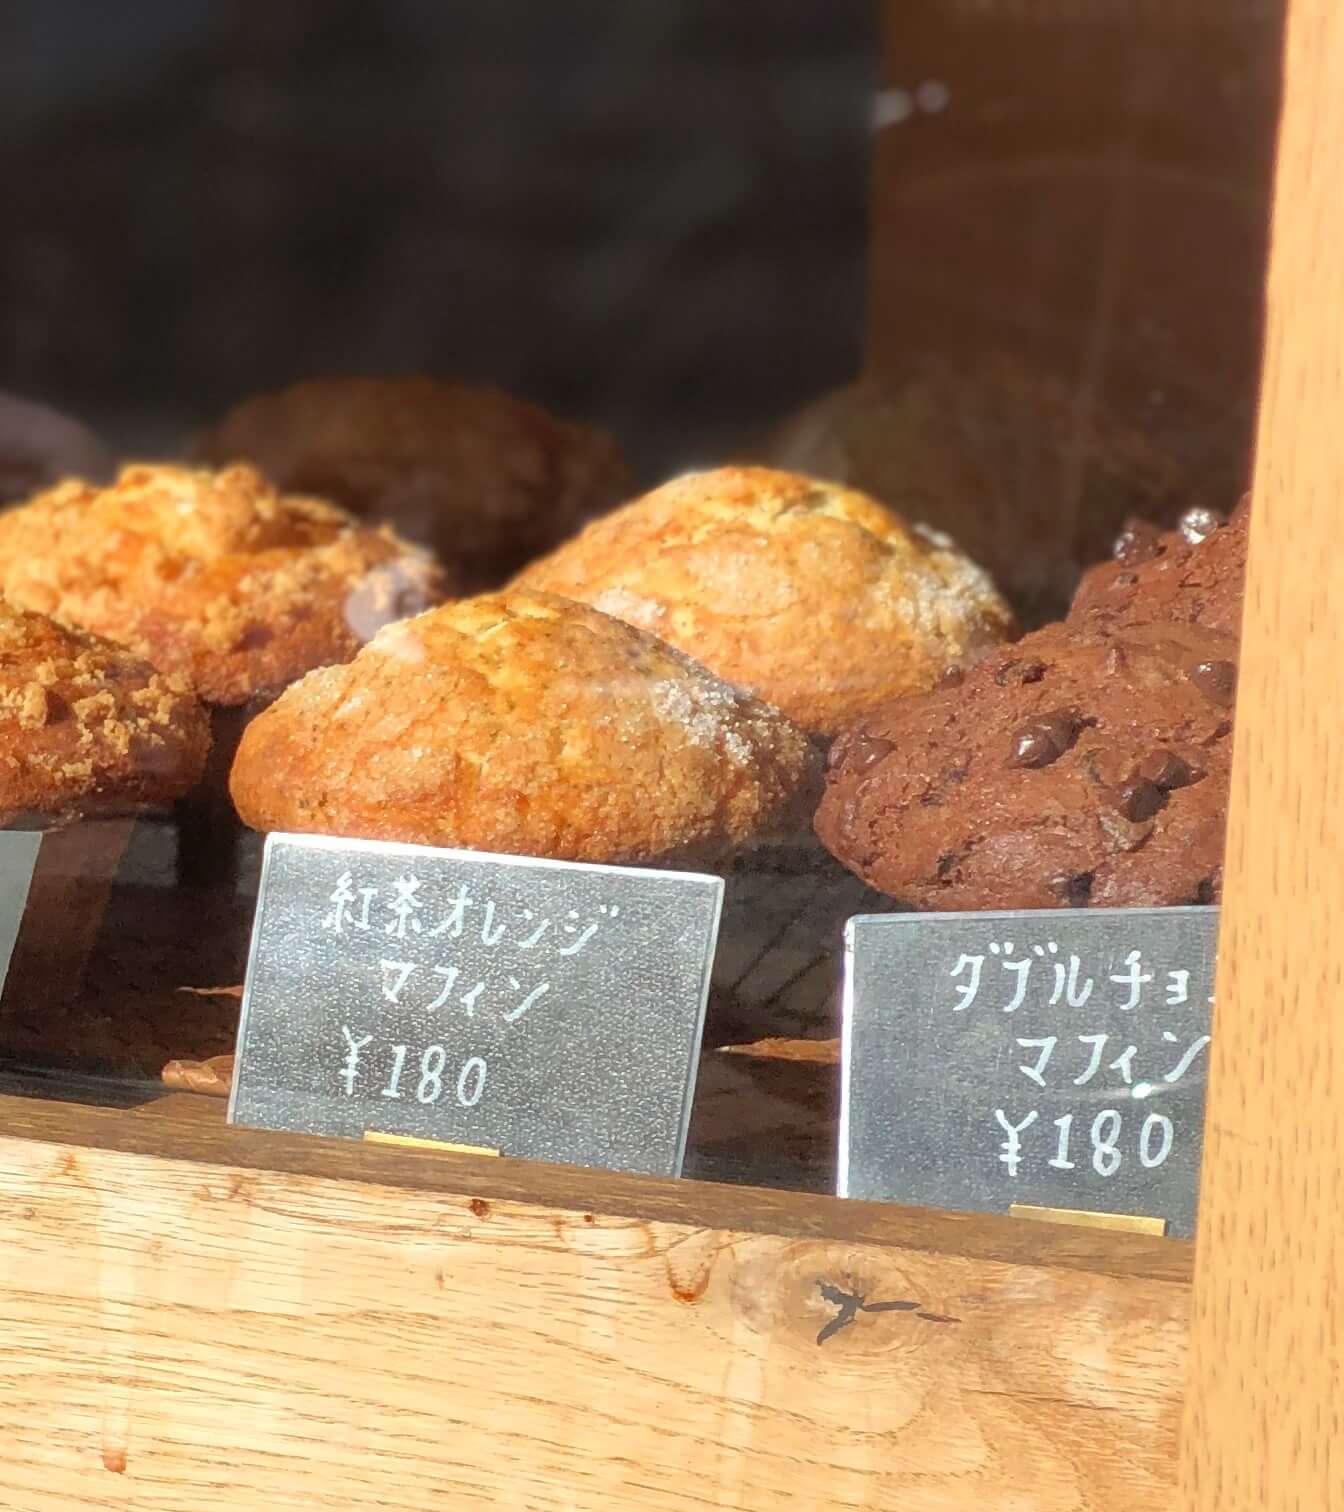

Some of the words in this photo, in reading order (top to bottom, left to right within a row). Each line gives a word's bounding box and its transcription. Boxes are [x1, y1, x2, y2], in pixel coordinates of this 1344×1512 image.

[322, 870, 619, 956] 紅茶オレンジ
[380, 958, 550, 1022] マフィン
[950, 941, 1216, 1012] ダブルチョ
[341, 1024, 488, 1106] ¥180
[1015, 1031, 1211, 1084] マフィン
[994, 1108, 1174, 1177] ¥180
